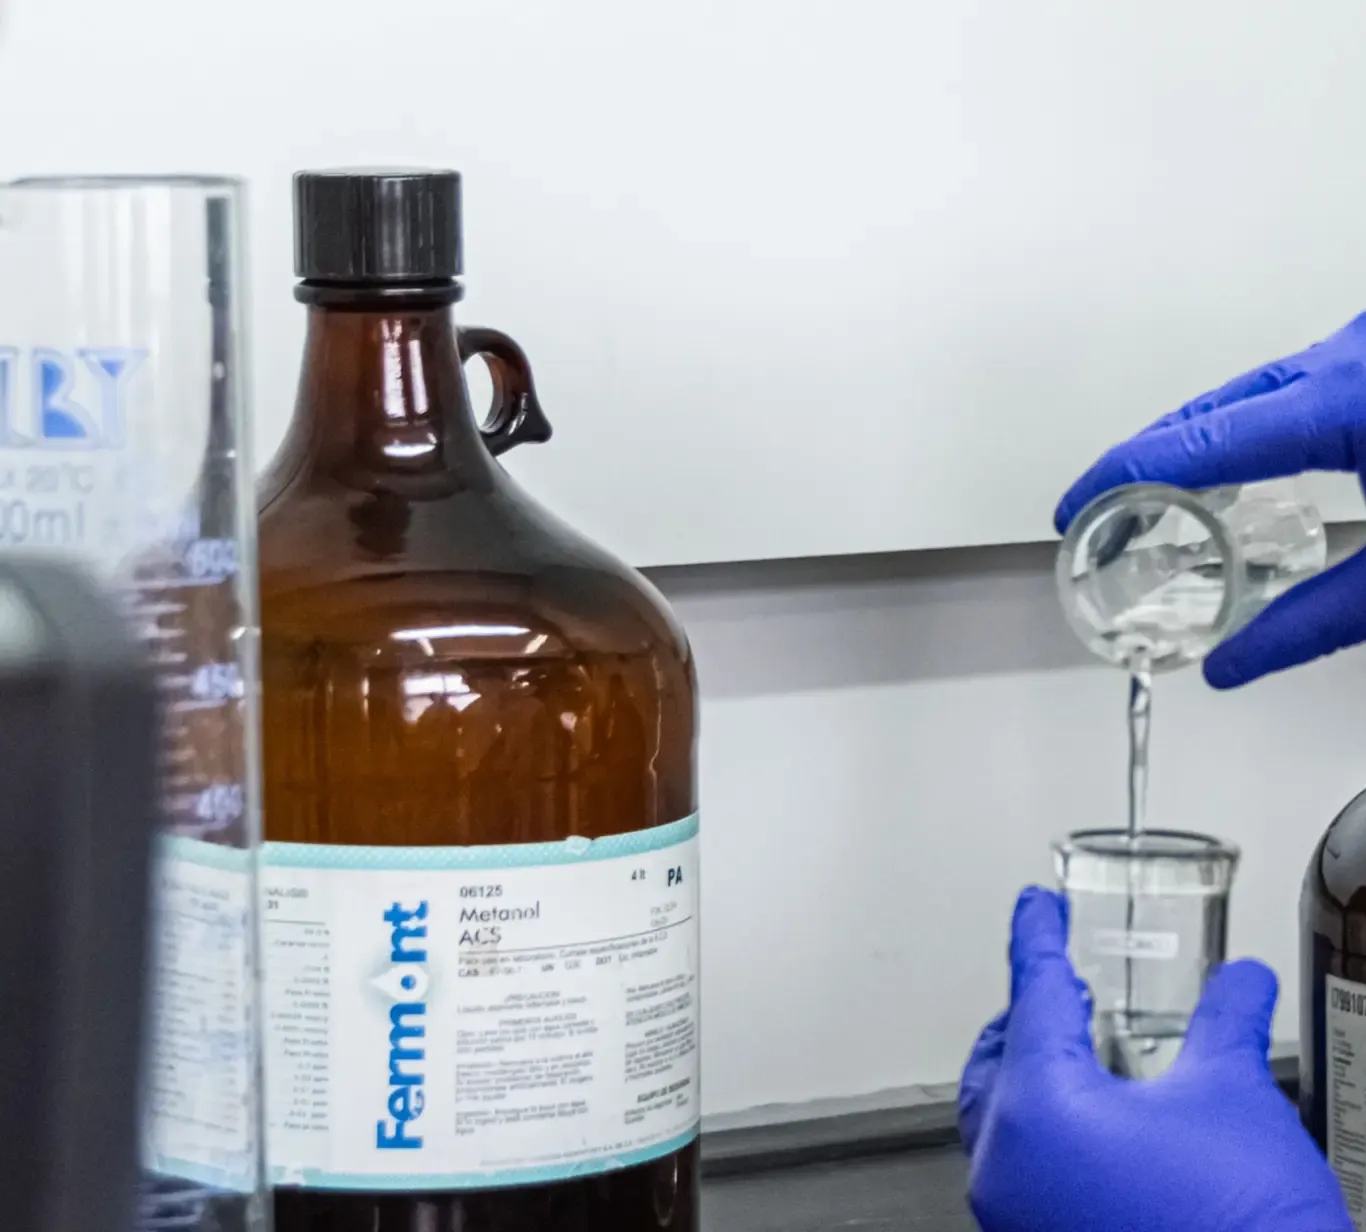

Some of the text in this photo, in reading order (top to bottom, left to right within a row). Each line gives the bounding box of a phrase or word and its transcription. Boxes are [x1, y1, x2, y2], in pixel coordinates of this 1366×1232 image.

[667, 865, 684, 887] PA
[459, 884, 503, 899] 06125
[459, 900, 540, 923] Metanol
[458, 925, 502, 946] ACS
